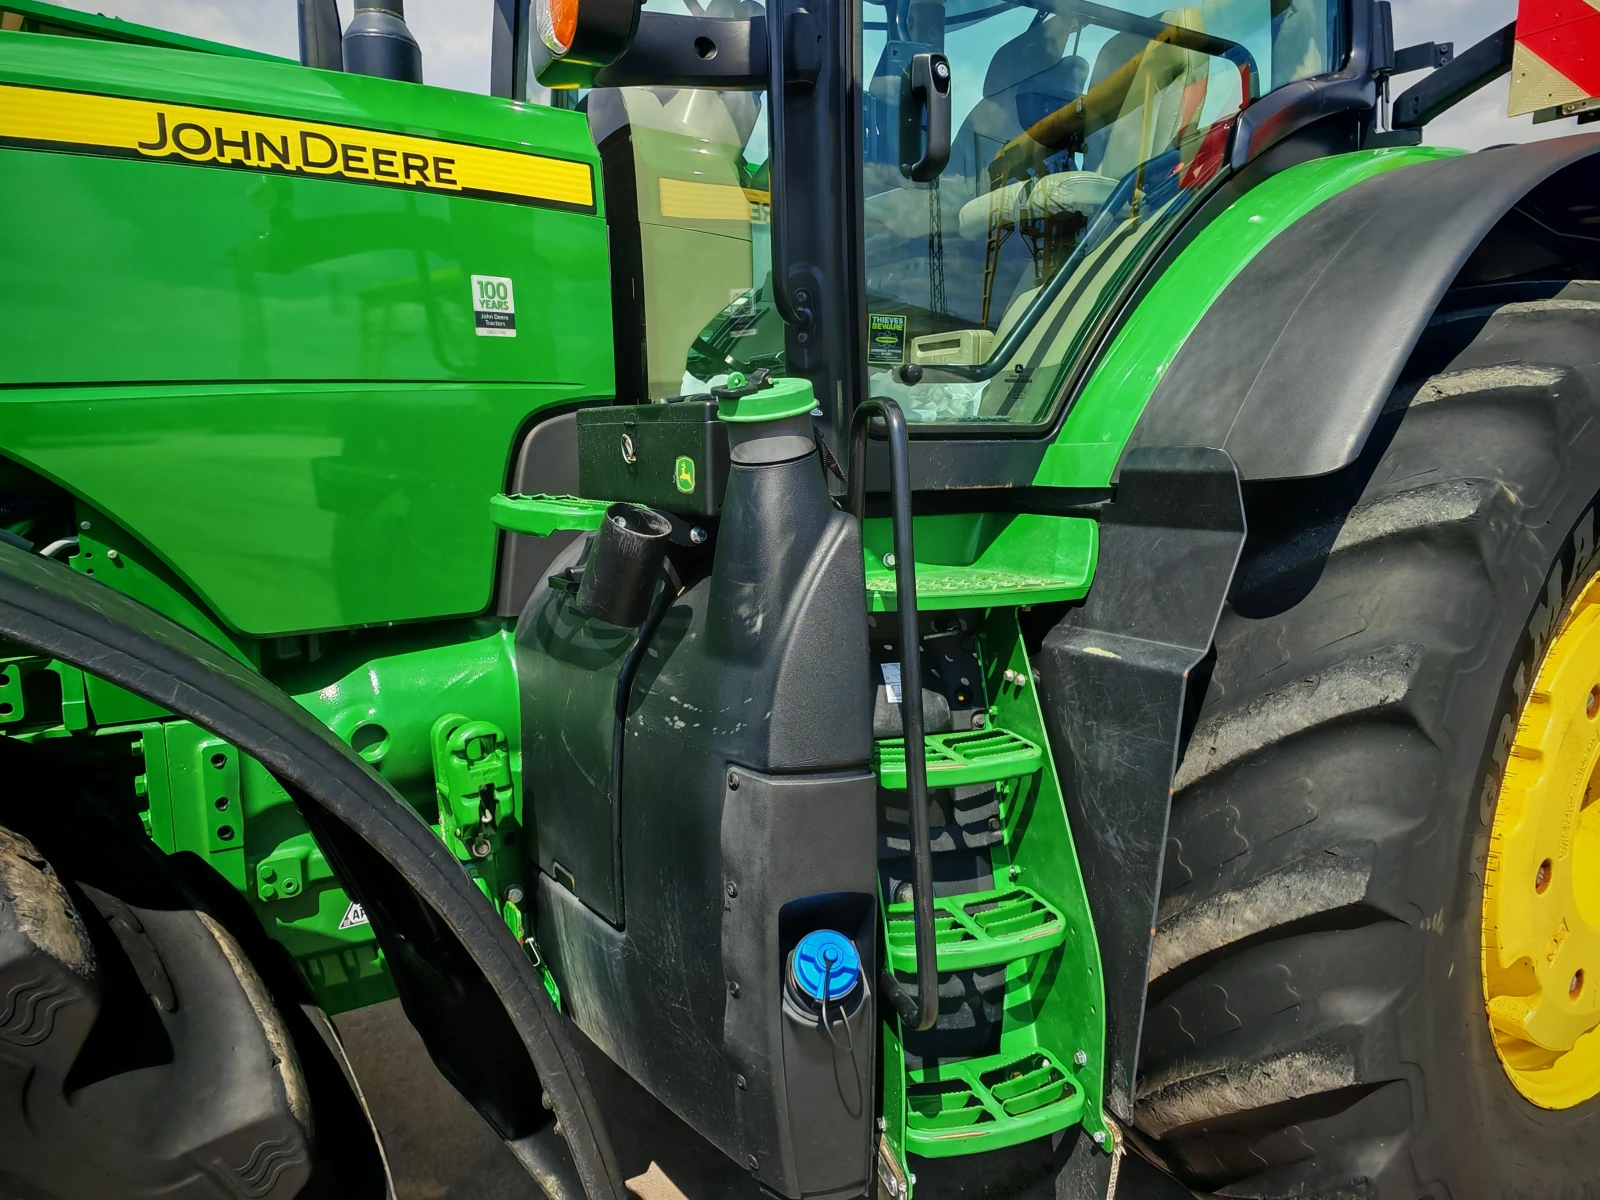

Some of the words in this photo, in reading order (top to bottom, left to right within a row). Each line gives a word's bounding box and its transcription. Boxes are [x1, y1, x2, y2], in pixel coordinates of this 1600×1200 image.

[138, 112, 290, 164] JOHN
[301, 131, 457, 184] DEERE
[477, 281, 507, 300] 100
[479, 300, 509, 310] YEARS
[872, 323, 903, 331] BEWARE
